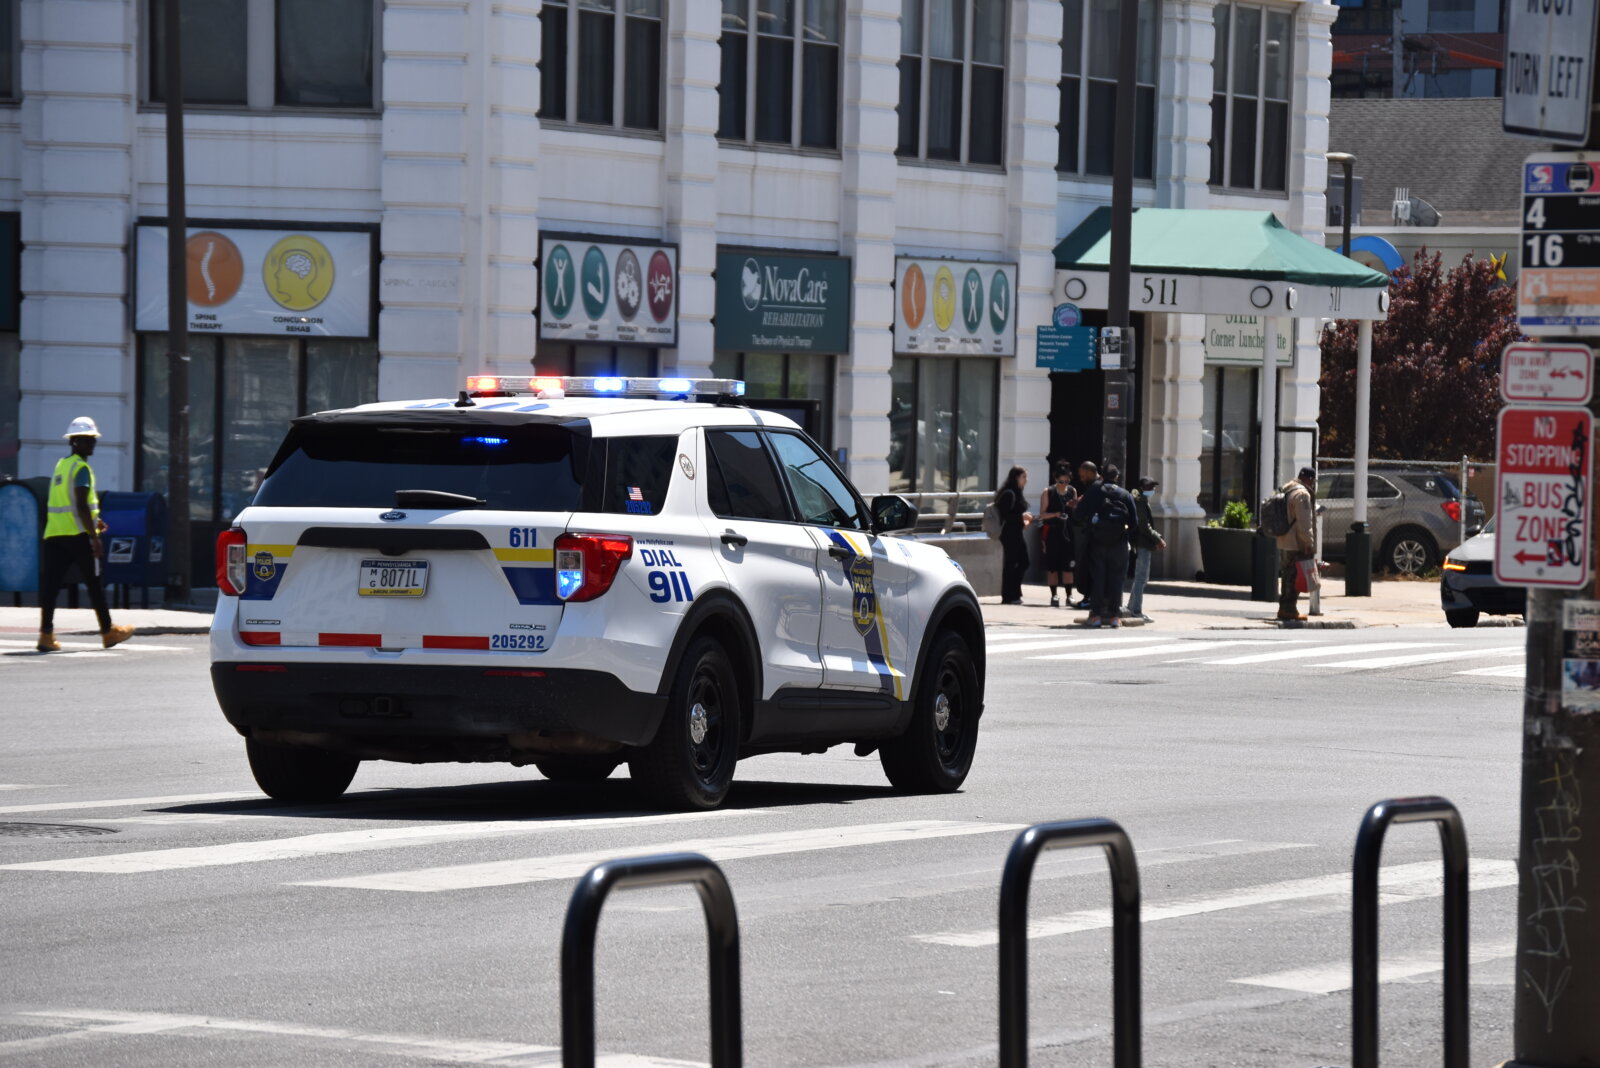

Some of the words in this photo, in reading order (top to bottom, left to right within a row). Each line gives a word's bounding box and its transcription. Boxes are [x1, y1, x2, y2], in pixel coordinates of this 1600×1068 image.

[1509, 52, 1541, 96] TURN
[1548, 55, 1583, 99] LEFT
[1526, 197, 1546, 229] 4
[1526, 234, 1564, 267] 16
[762, 265, 828, 304] NovaCare
[1141, 277, 1178, 306] 511
[189, 322, 223, 331] THERAPY
[194, 313, 217, 322] SPINE
[761, 311, 824, 328] REHABILITATION
[1210, 328, 1235, 347] Corner
[1519, 369, 1540, 380] ZONE
[1533, 416, 1557, 439] NO
[1523, 481, 1563, 509] BUS
[509, 527, 537, 548] 611
[639, 549, 682, 568] DIAL
[369, 580, 376, 588] G
[370, 568, 377, 576] M
[380, 568, 419, 588] 8071L
[647, 570, 694, 604] 911
[491, 634, 545, 649] 205292
